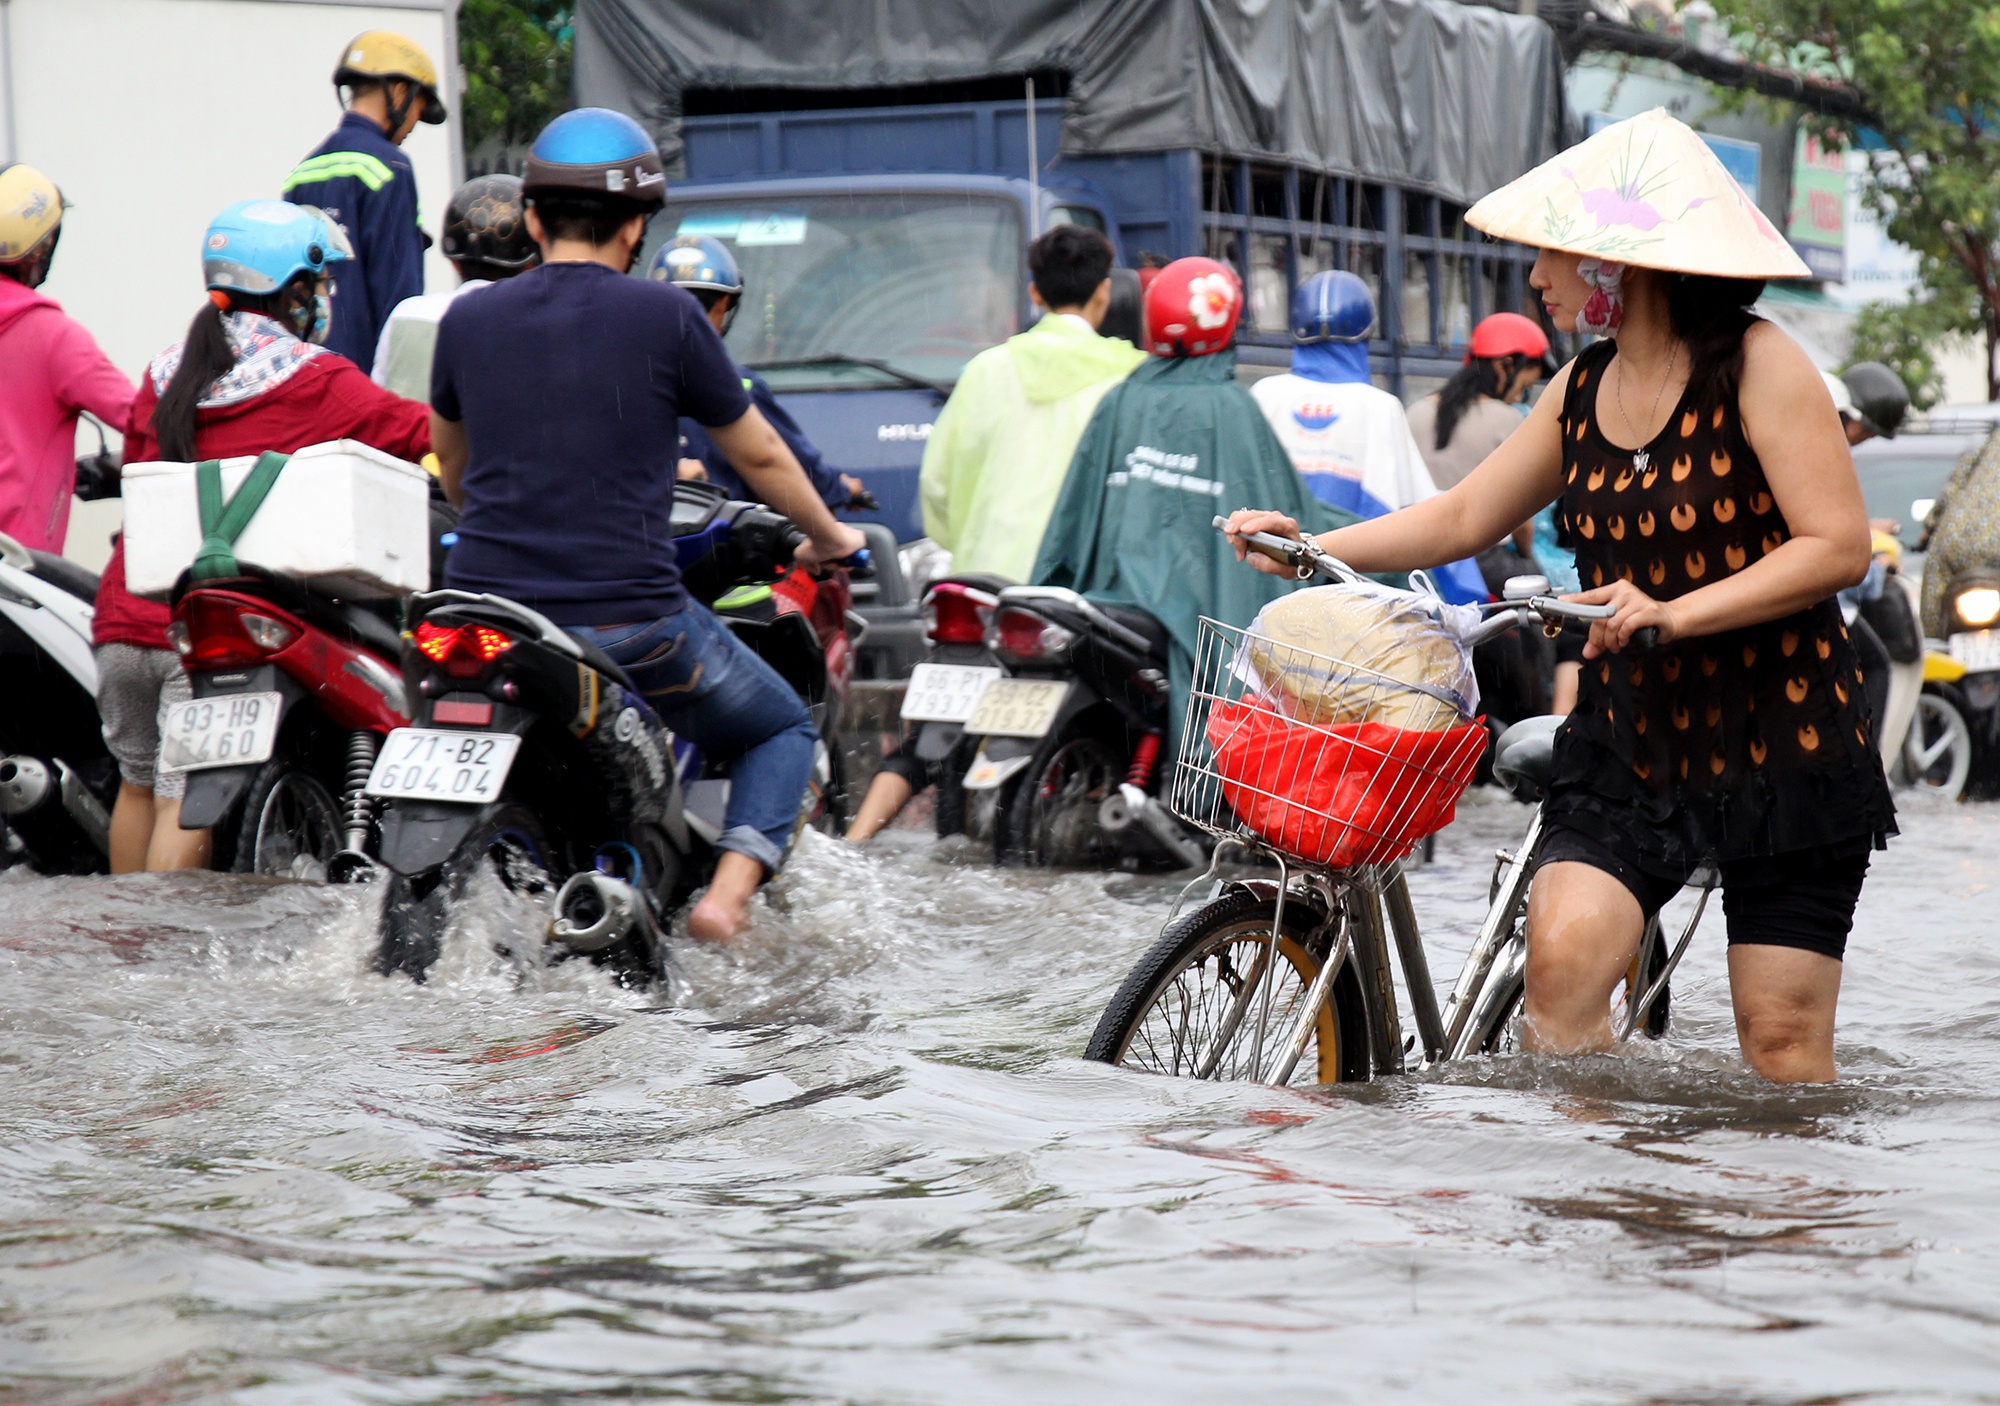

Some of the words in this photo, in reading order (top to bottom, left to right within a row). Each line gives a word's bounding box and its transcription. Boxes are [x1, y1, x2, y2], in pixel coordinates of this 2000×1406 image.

[181, 699, 261, 734] 93-H9
[403, 735, 495, 765] 71-B2
[380, 764, 491, 795] 604.04
